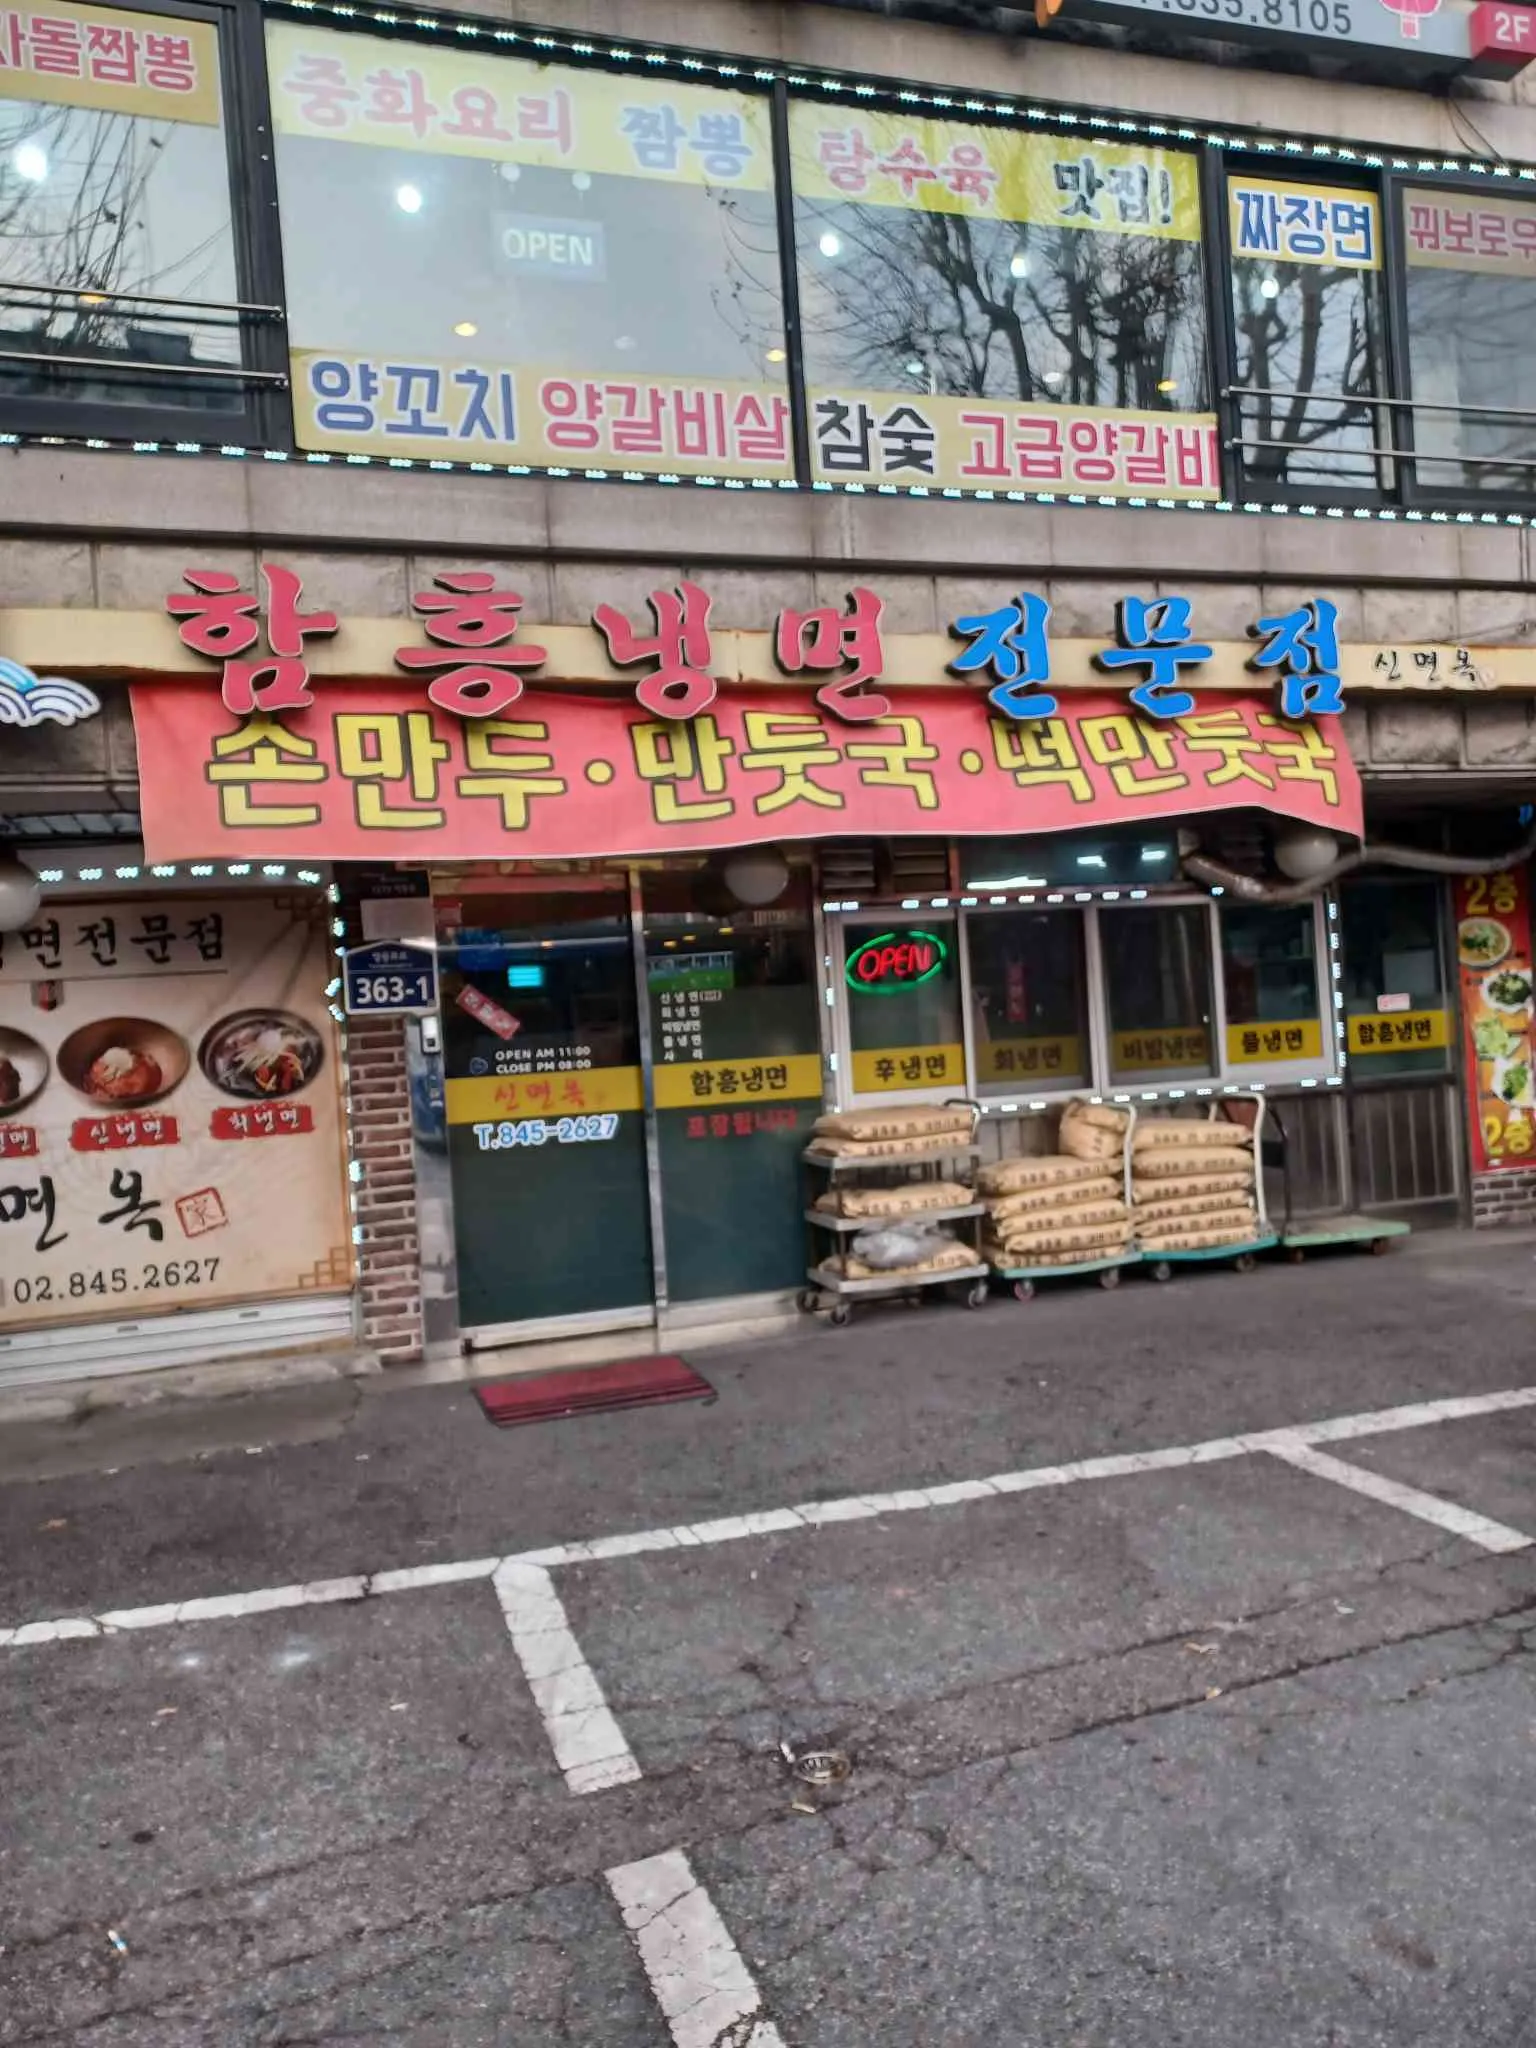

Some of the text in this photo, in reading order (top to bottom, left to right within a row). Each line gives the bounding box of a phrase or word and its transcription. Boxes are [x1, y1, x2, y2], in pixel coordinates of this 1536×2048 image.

[1493, 12, 1531, 42] 2F
[284, 55, 754, 177] 중화요리 짬뽕
[819, 127, 1173, 224] 탕수육 맛집!
[1237, 191, 1374, 262] 짜장면
[502, 229, 593, 266] OPEN
[310, 360, 789, 461] 양꼬치 양갈비살
[816, 402, 1219, 487] 참숯 고급양갈비
[166, 562, 1345, 722] 함흥냉면 전문점
[1374, 648, 1476, 682] 신면옥
[206, 708, 1340, 830] 손만두 만둣국 떡만둣국
[1464, 873, 1518, 914] 2층
[0, 912, 224, 970] 면전문점
[857, 944, 931, 982] OPEN
[355, 975, 429, 1004] 363-1
[1358, 1018, 1432, 1046] 함흥냉면
[495, 1046, 591, 1061] OPEN AM 11:00
[495, 1062, 531, 1074] CLOSE
[536, 1060, 555, 1072] PM
[494, 1078, 587, 1111] 신면옥
[690, 1063, 788, 1096] 함흥냉면
[474, 1115, 620, 1150] T.845-2627
[13, 1257, 221, 1304] 02.845.2627
